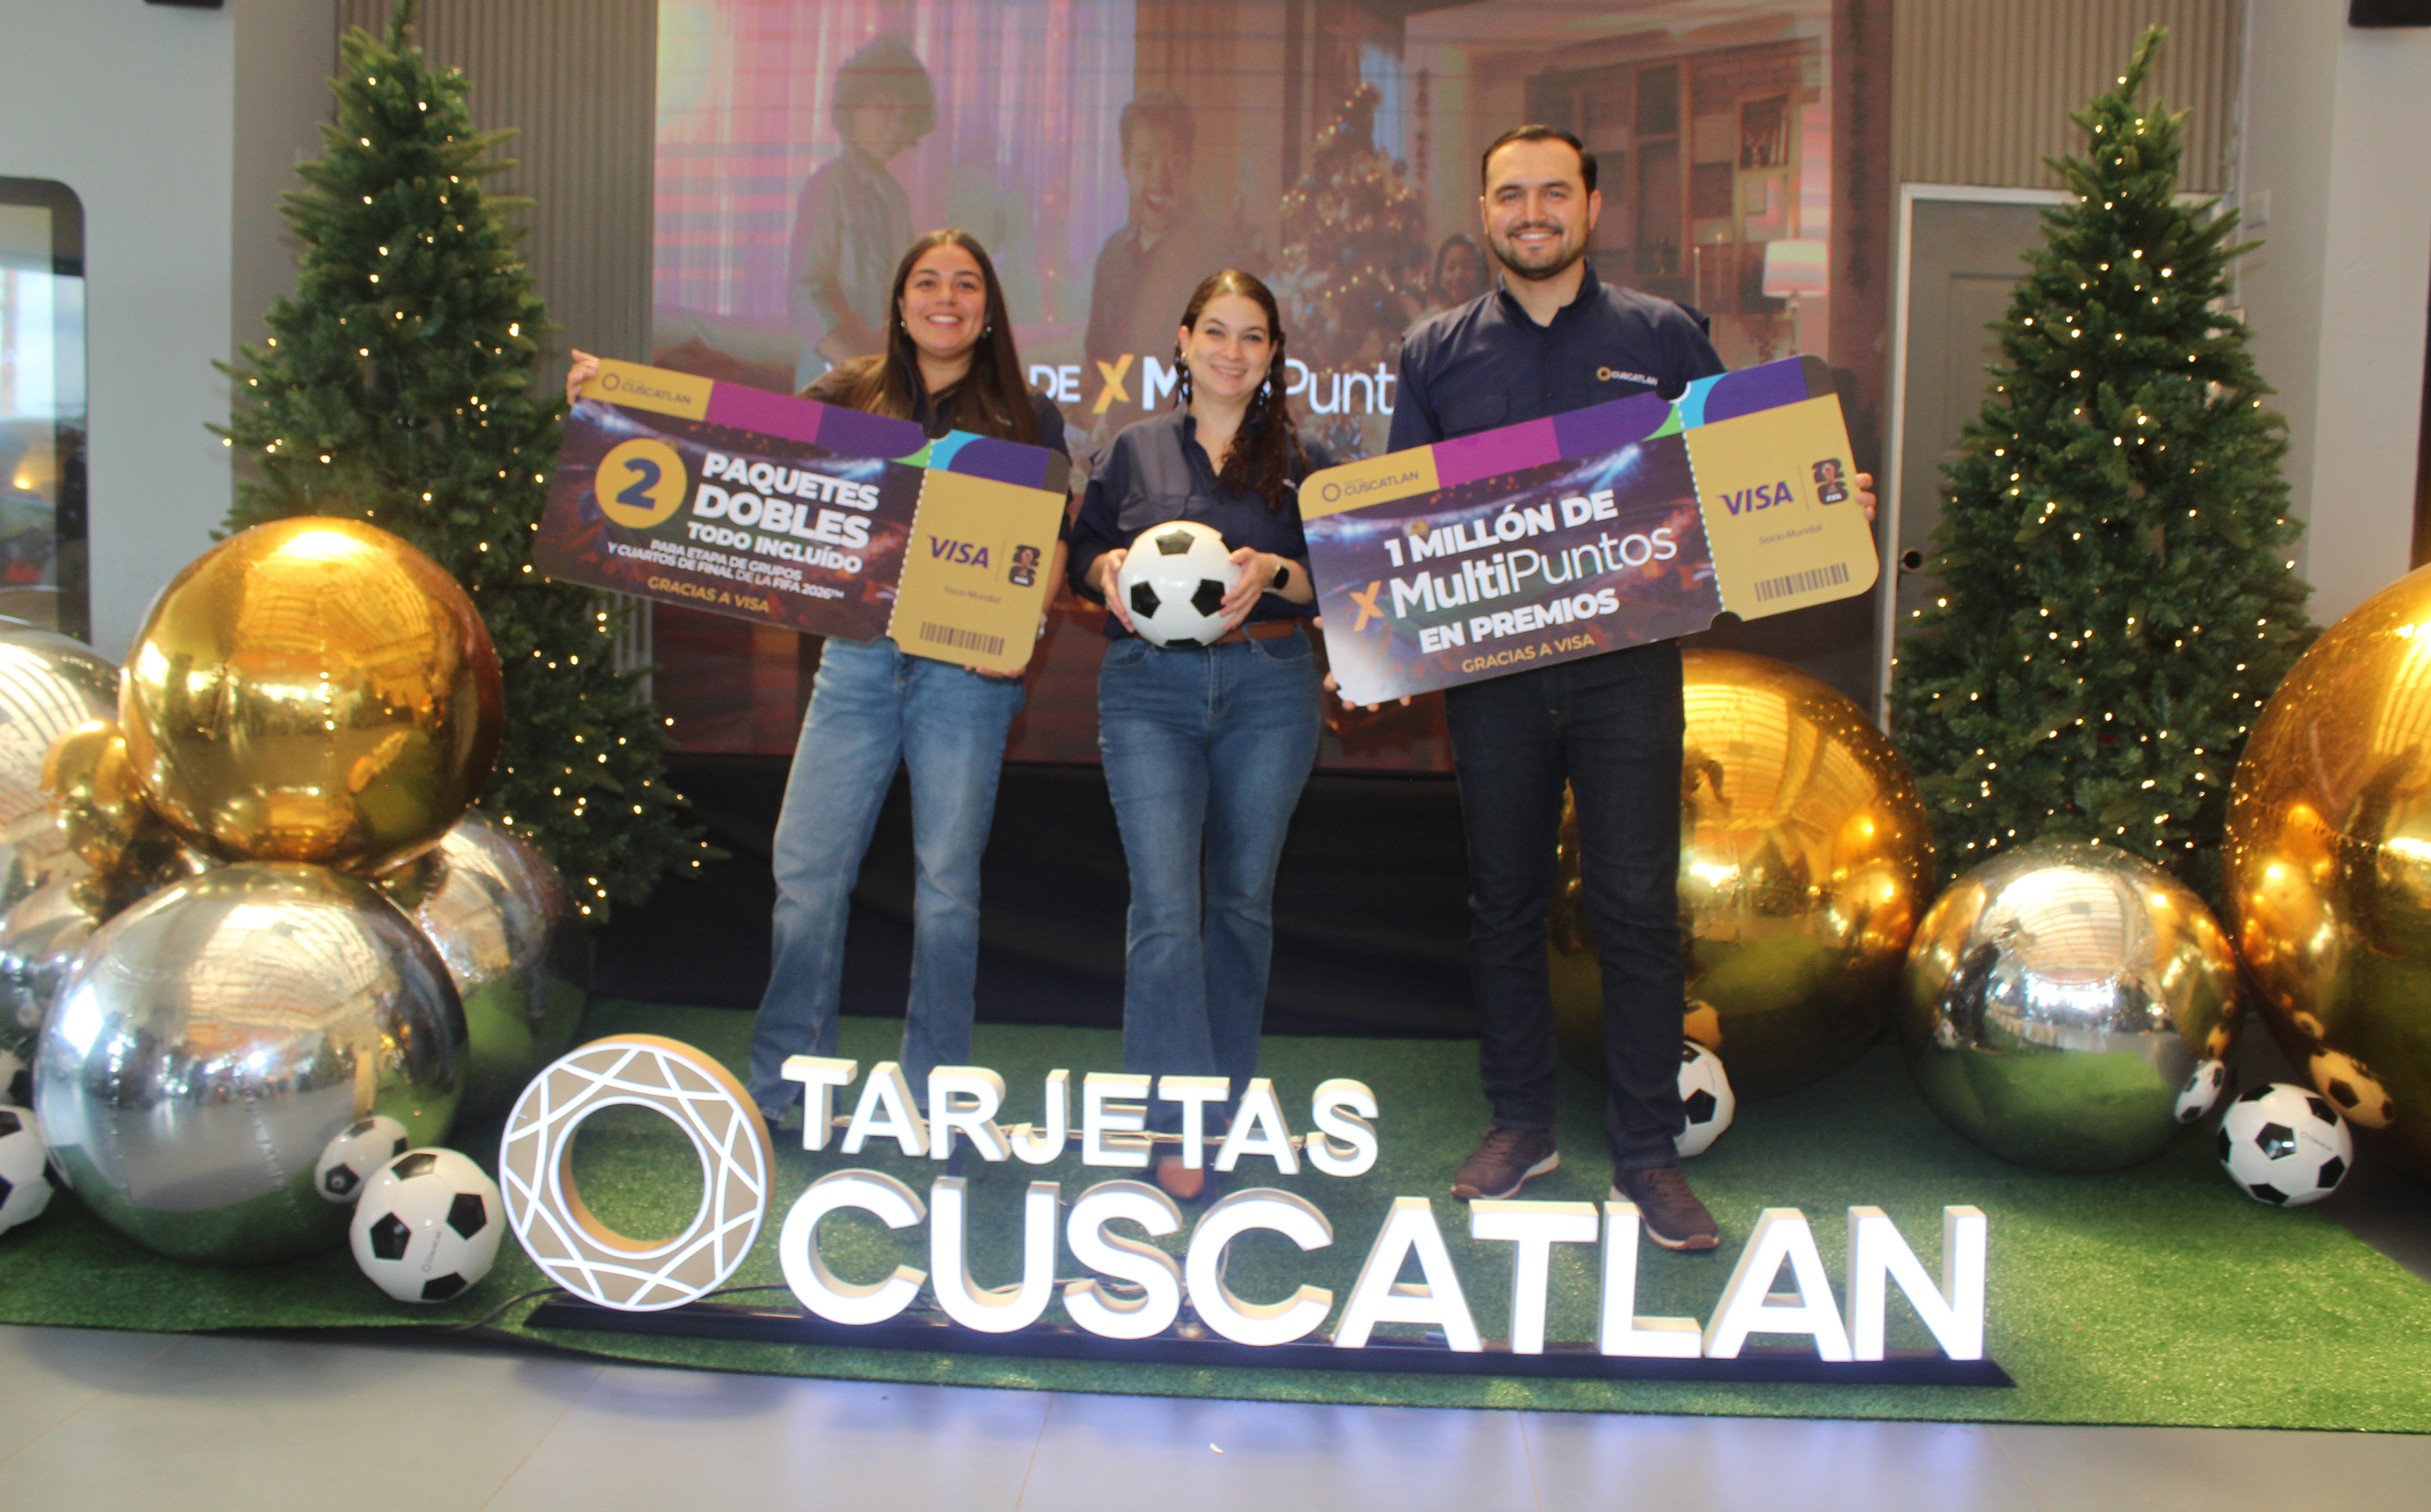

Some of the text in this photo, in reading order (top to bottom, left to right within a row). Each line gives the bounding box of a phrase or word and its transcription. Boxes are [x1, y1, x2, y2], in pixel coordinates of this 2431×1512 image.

[622, 381, 691, 404] CUSCATLAN
[1029, 365, 1081, 402] DE
[615, 457, 662, 510] 2
[702, 451, 880, 511] PAQUETES
[1344, 471, 1419, 496] CUSCATLAN
[1717, 481, 1794, 516] VISA
[692, 483, 872, 549] DOBLES
[1384, 489, 1619, 567] 1 MILLÓN DE
[608, 542, 617, 553] Y
[618, 544, 677, 567] CUARTOS
[675, 556, 696, 571] DE
[697, 559, 734, 579] FINAL
[735, 567, 756, 583] DE
[756, 571, 772, 587] LA
[773, 575, 801, 593] FIFA
[650, 539, 803, 581] PARA ETAPA DE GRUPOS
[687, 521, 863, 574] TODO INCLUÍDO
[928, 535, 989, 569] VISA
[1389, 527, 1678, 619] MultiPuntos
[647, 575, 770, 613] GRACIAS A VISA
[1419, 588, 1620, 654] EN PREMIOS
[1461, 633, 1596, 674] GRACIAS A VISA
[780, 1055, 1380, 1176] TARJETAS
[778, 1167, 1988, 1363] CUSCATLAN
